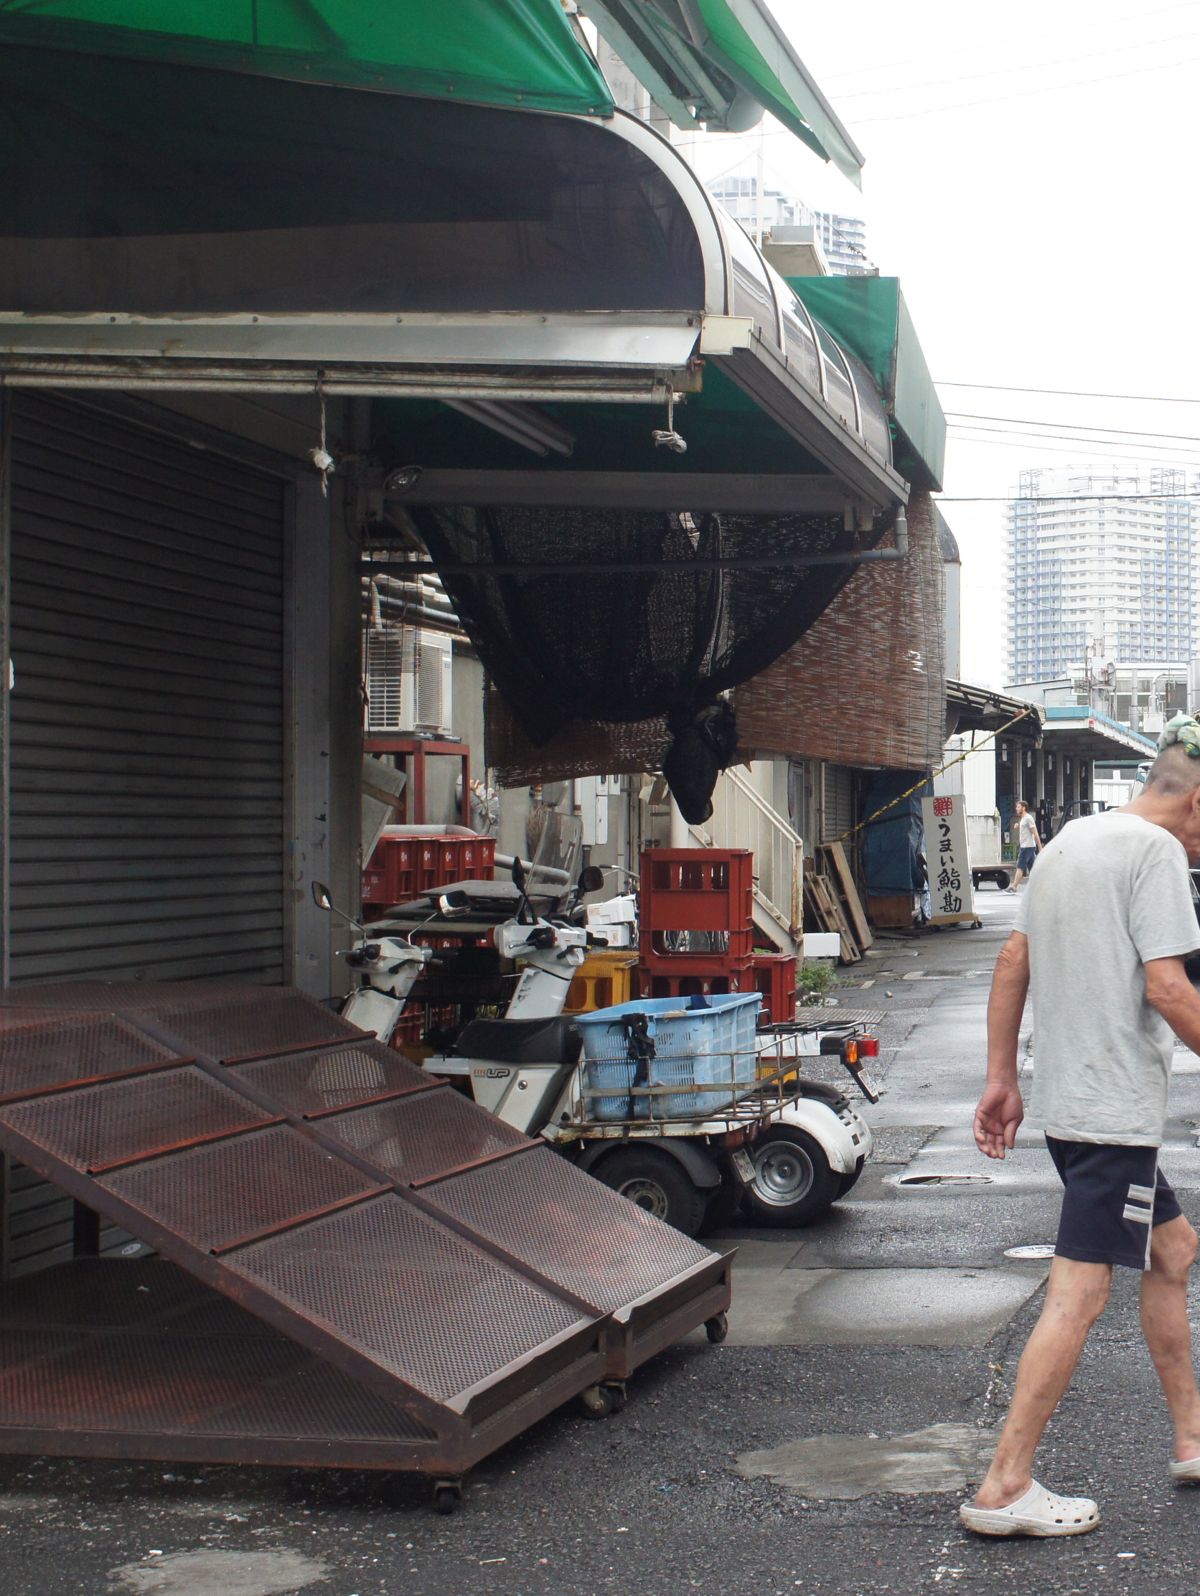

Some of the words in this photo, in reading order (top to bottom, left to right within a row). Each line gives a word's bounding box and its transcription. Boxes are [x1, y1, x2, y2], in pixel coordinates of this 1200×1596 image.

[937, 817, 963, 913] うまい鮨勘
